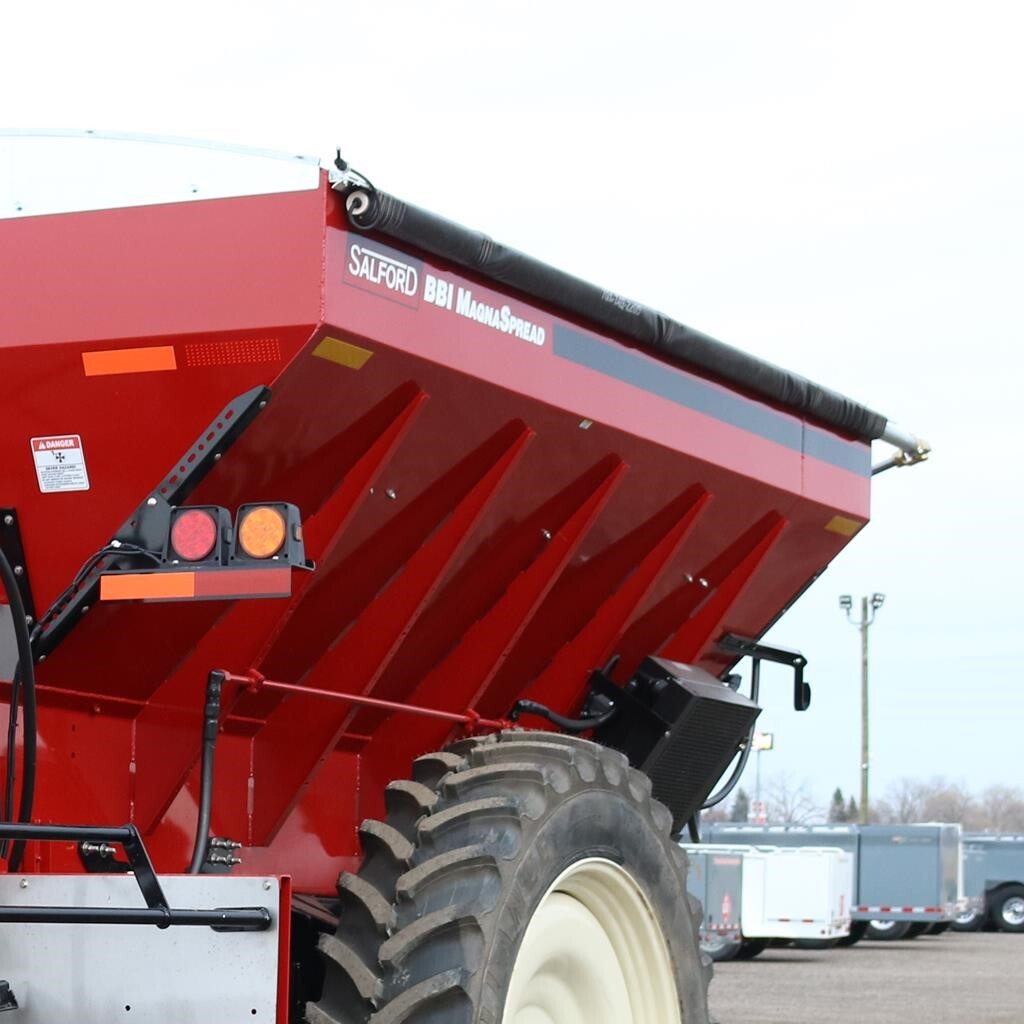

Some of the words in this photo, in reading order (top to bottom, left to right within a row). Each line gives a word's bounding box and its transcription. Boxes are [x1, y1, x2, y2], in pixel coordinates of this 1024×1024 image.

[348, 244, 418, 297] SALFORD
[423, 274, 454, 311] BBI
[46, 439, 74, 448] DANGER
